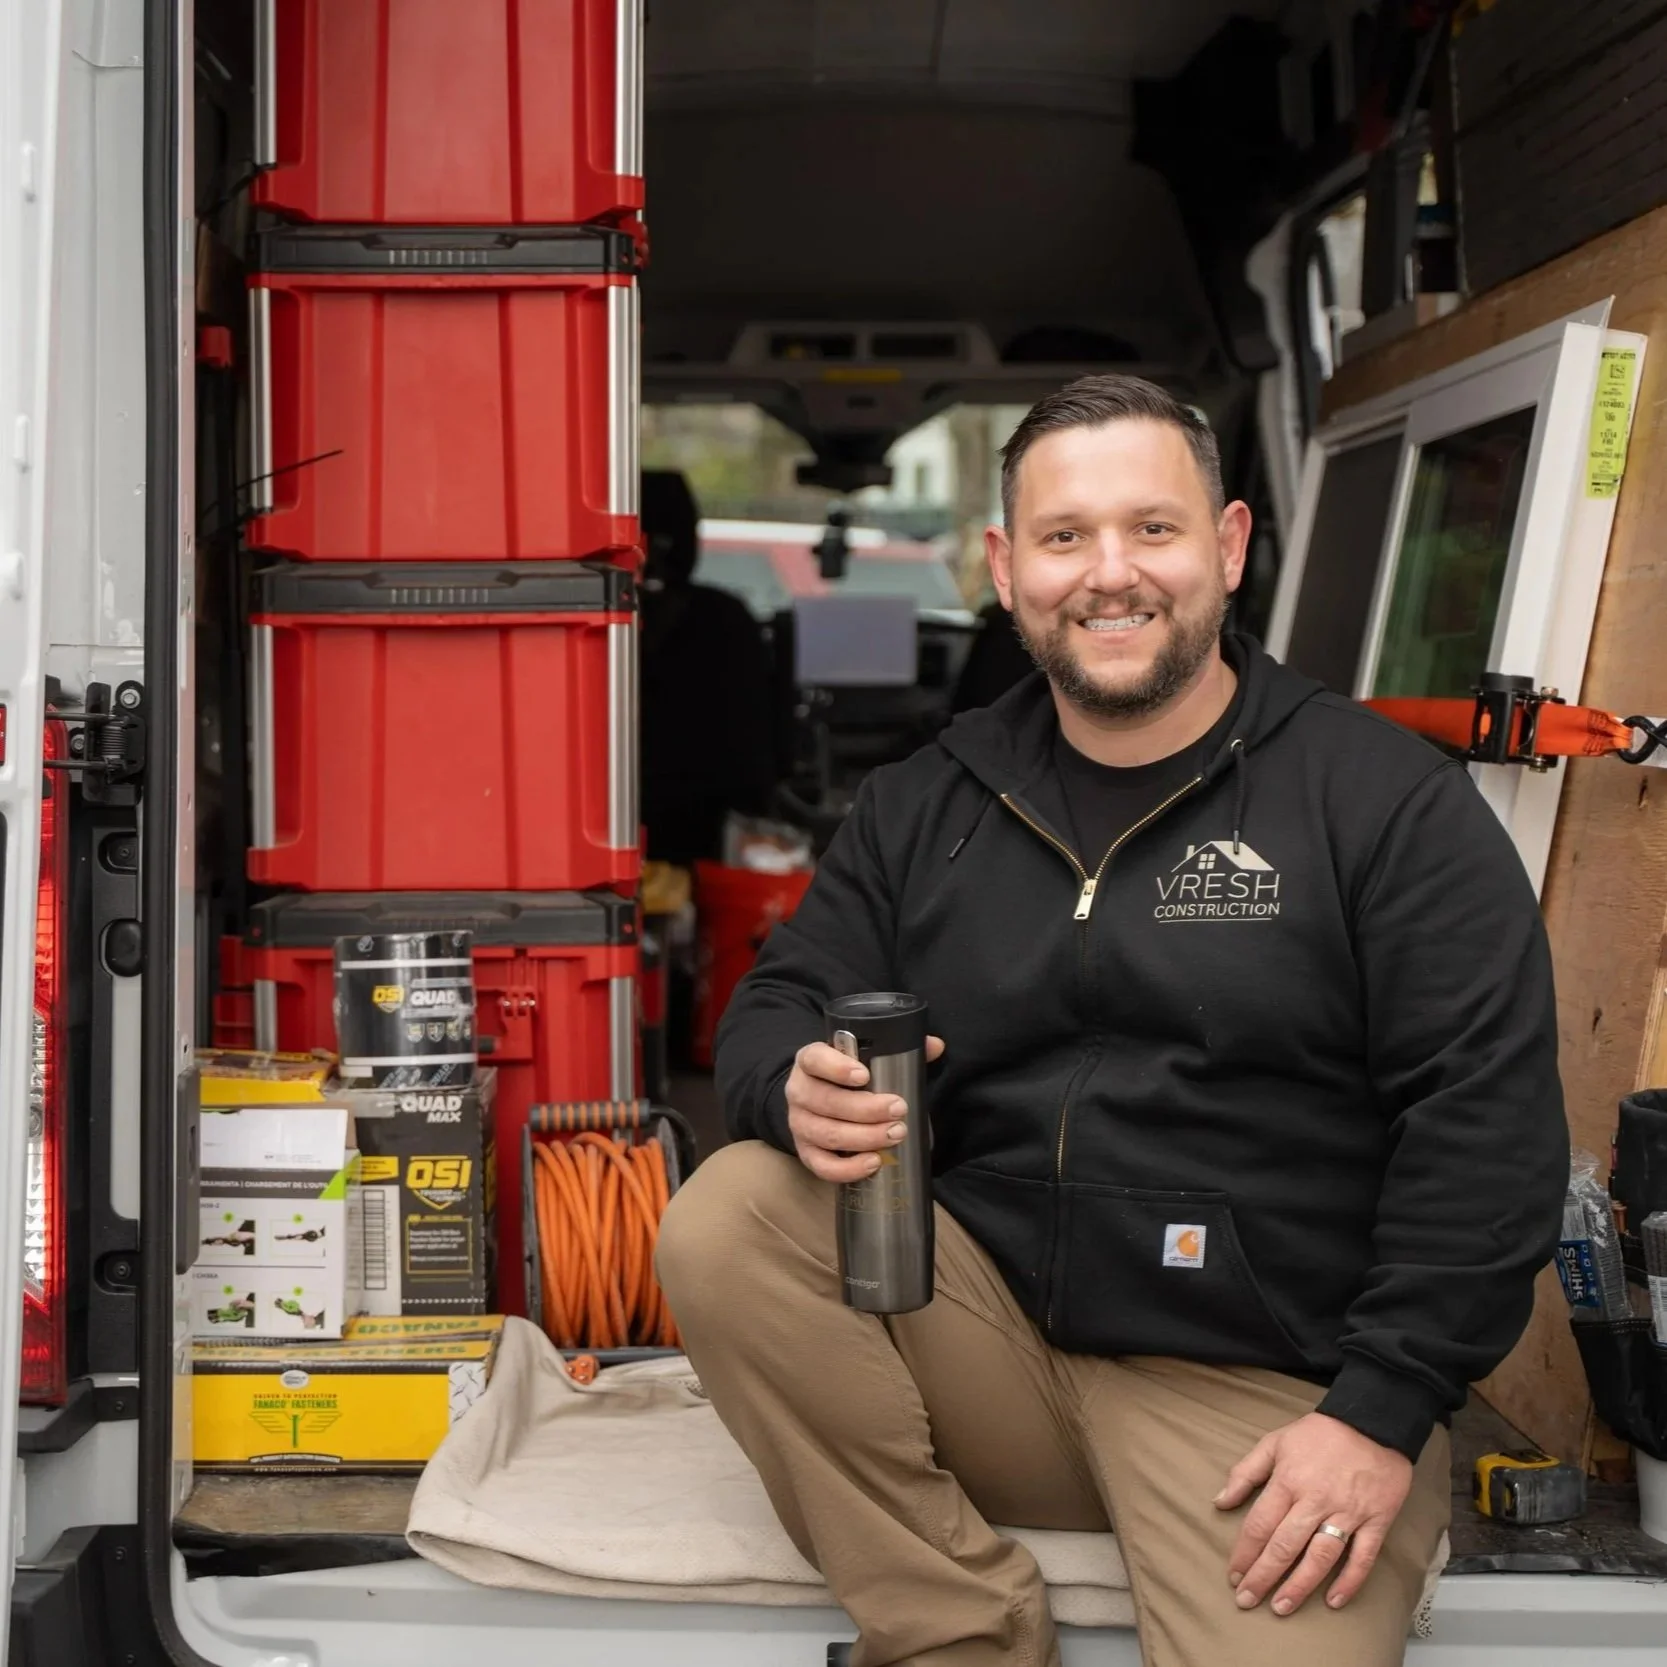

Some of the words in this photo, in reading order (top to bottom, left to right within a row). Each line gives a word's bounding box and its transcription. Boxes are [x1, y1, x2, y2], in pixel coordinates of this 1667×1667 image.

[1156, 873, 1280, 900] VRESH
[1154, 903, 1280, 918] CONSTRUCTION
[373, 986, 404, 1004] OSI
[410, 990, 458, 1006] QUAD
[401, 1095, 462, 1113] QUAD
[427, 1112, 462, 1123] MAX
[406, 1160, 472, 1189] OSI
[1564, 1247, 1584, 1299] SHIMS
[291, 1399, 338, 1409] FASTENERS
